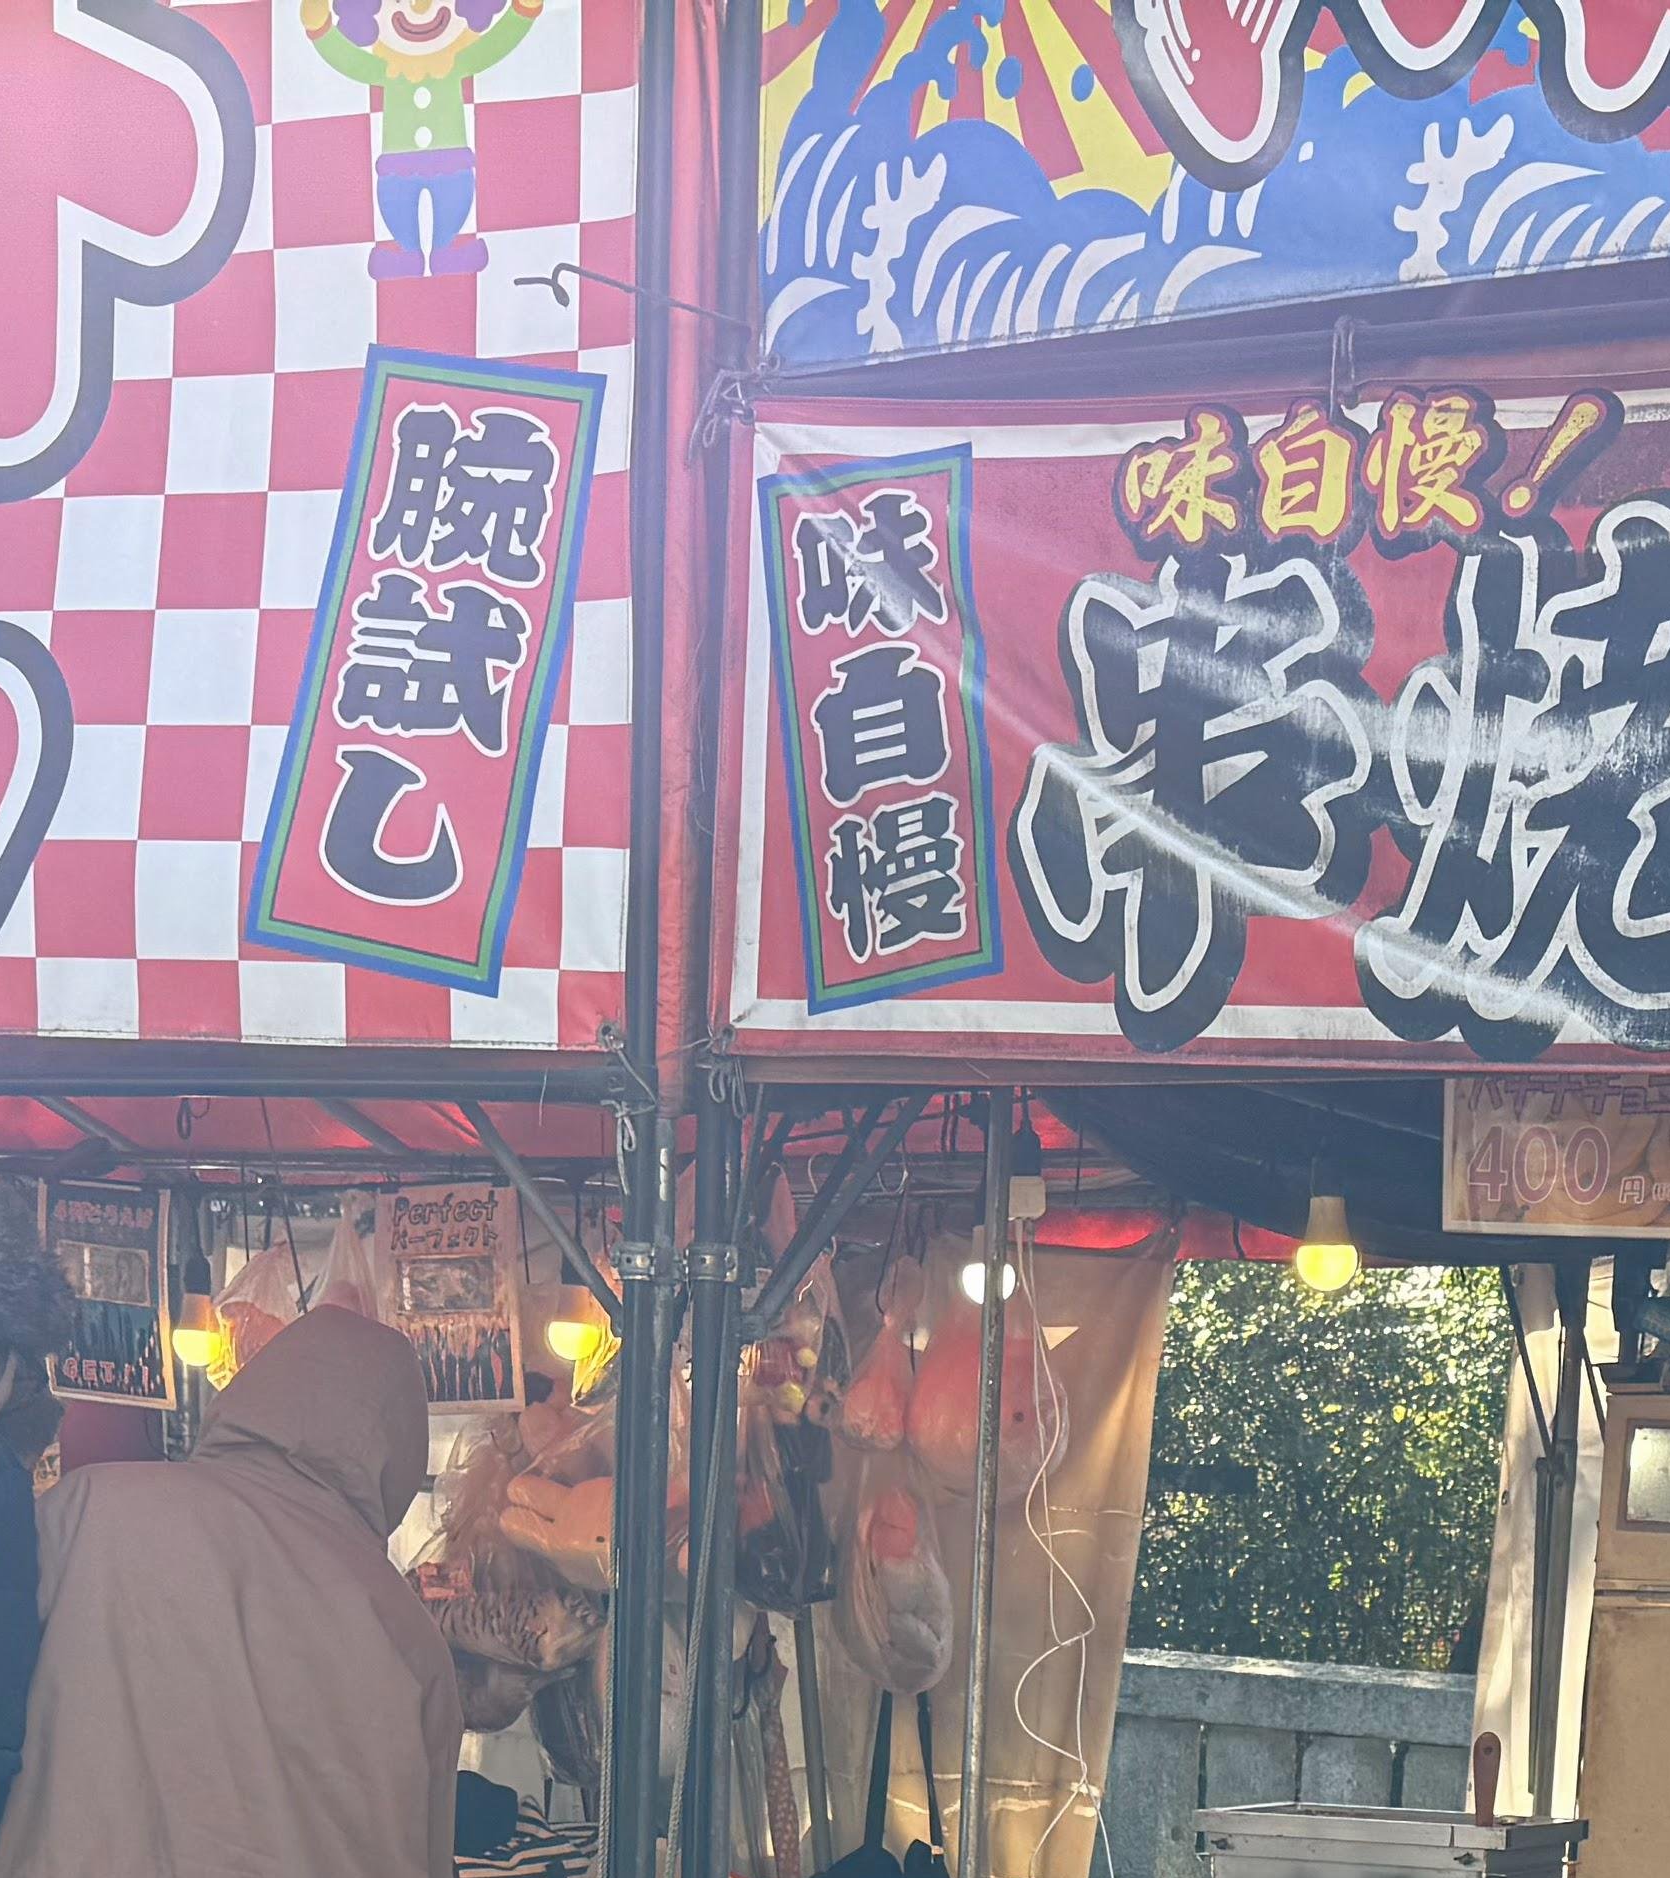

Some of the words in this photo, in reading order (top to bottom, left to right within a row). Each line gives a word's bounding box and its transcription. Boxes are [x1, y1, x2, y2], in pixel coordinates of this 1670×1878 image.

[1123, 392, 1613, 545] 味自慢!
[318, 403, 559, 907] 腕試し
[793, 486, 967, 966] 味自慢
[392, 1189, 499, 1227] Perfect
